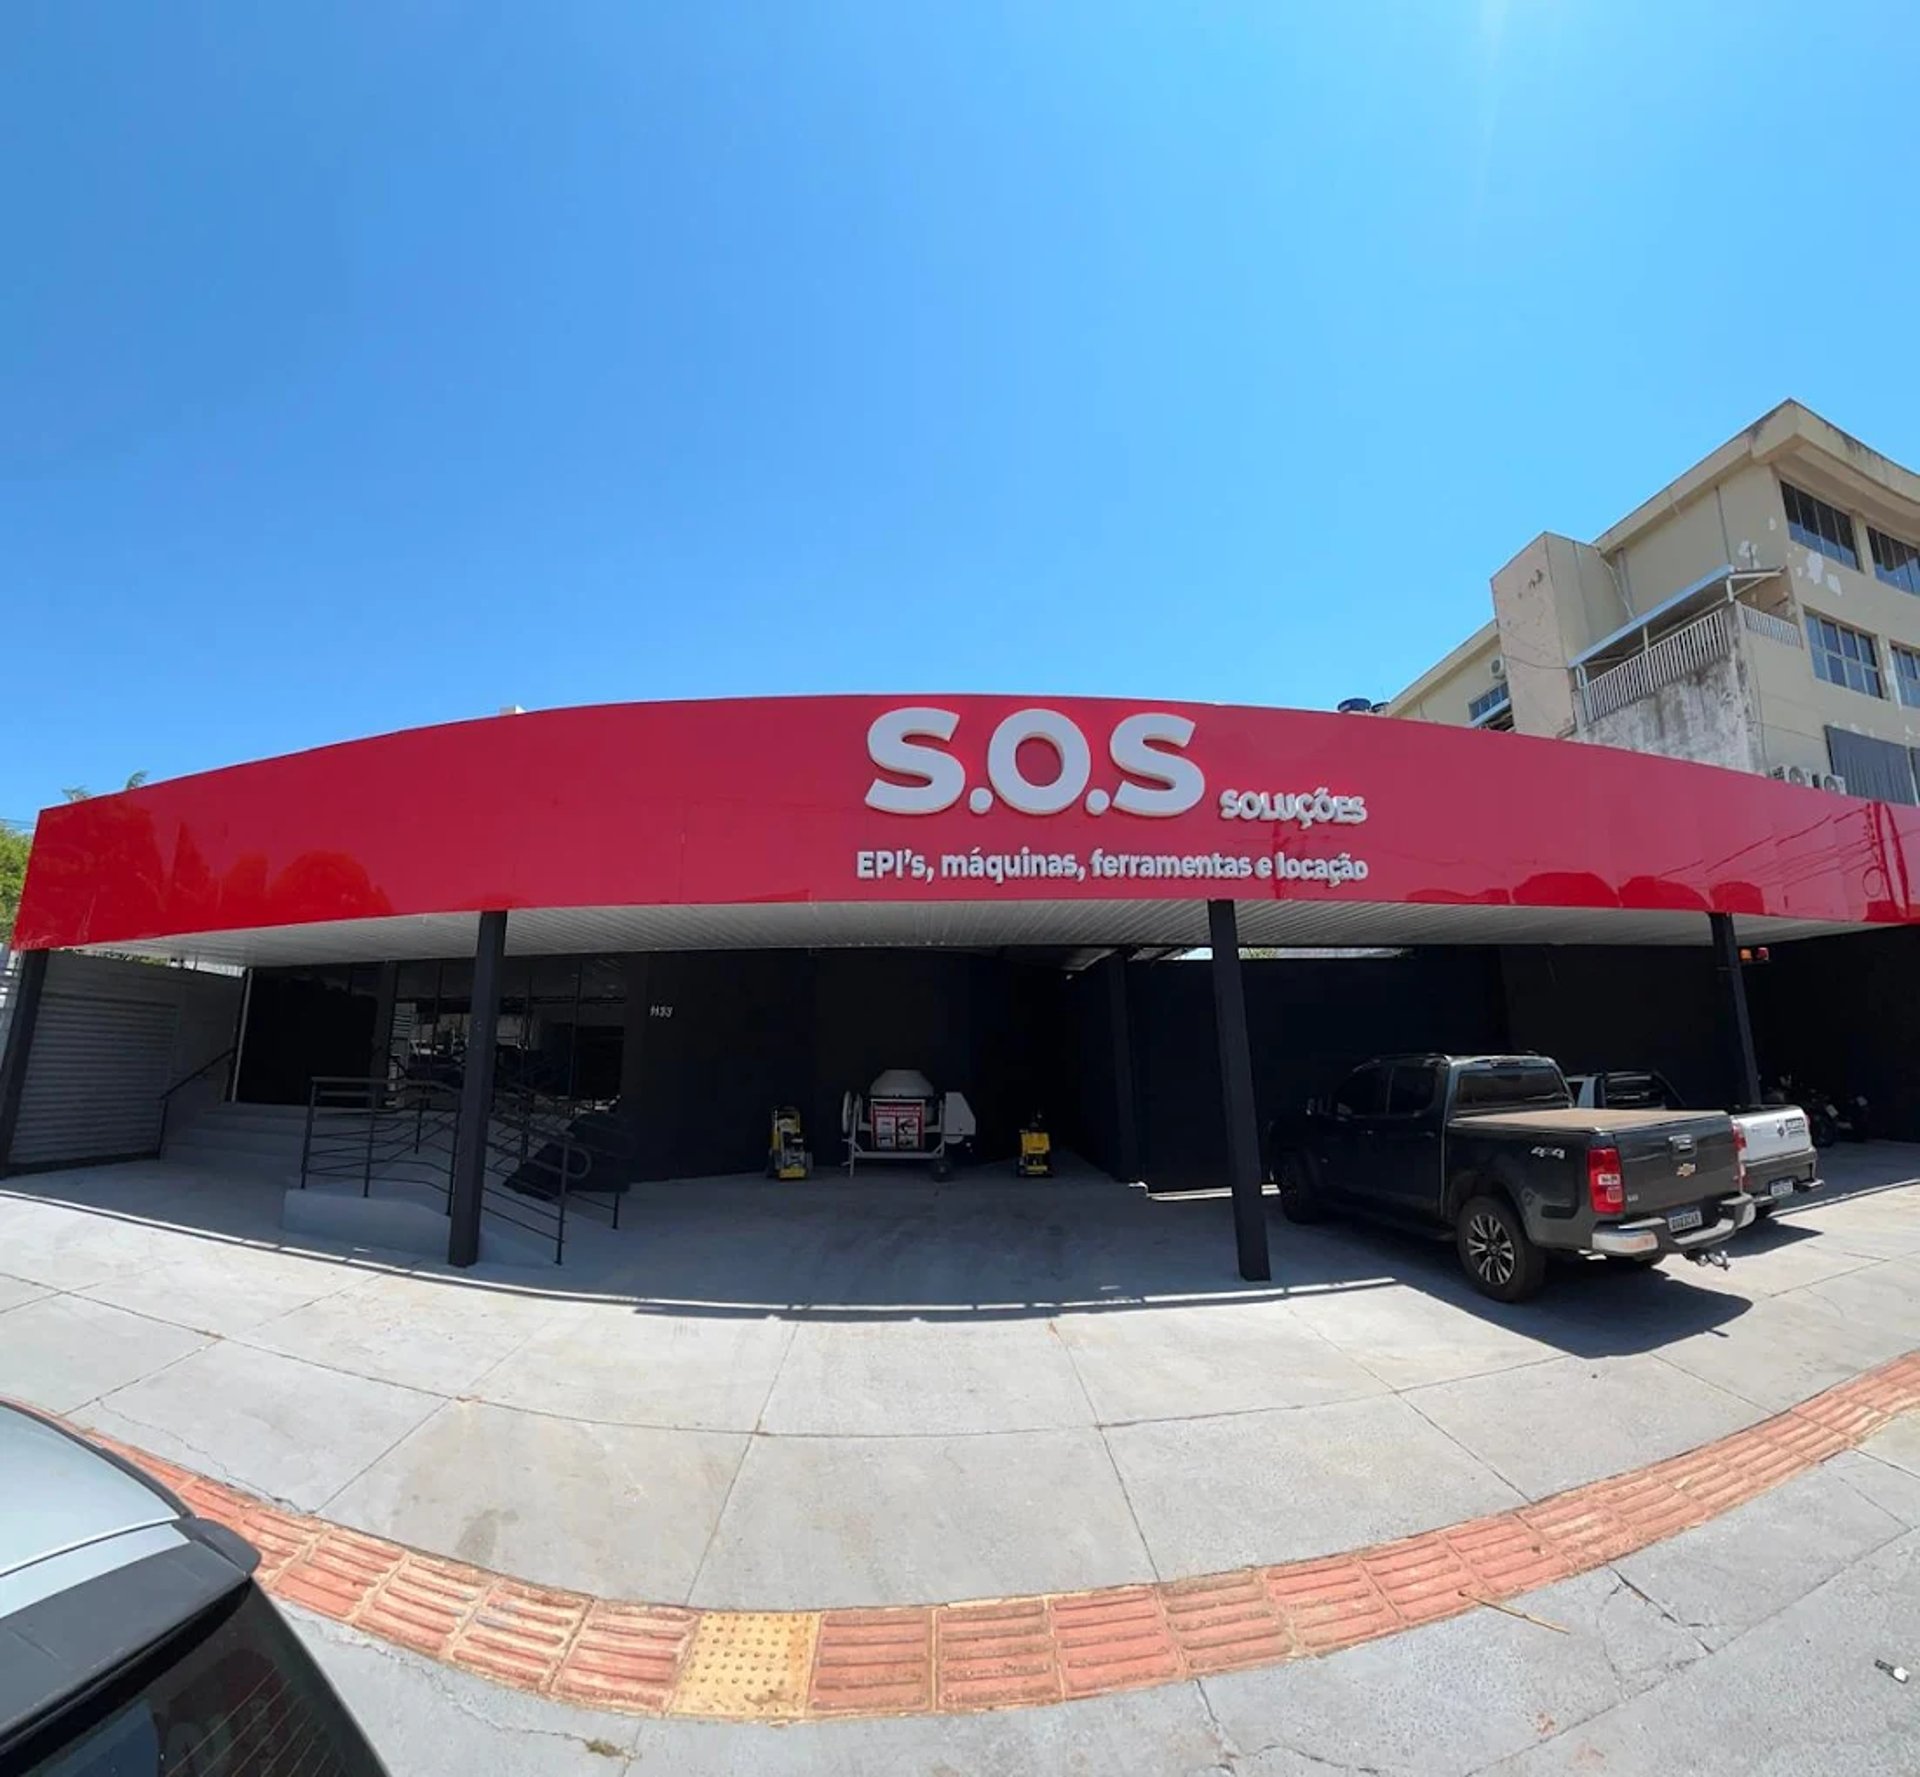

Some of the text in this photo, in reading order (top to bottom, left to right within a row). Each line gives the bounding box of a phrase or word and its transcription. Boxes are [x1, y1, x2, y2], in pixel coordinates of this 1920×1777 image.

[865, 707, 1368, 829] S.O.S SOLUÇÕES
[941, 846, 1085, 884] máquinas,
[1091, 848, 1253, 881] ferramentas
[1255, 855, 1272, 880] e
[1276, 851, 1369, 887] locação
